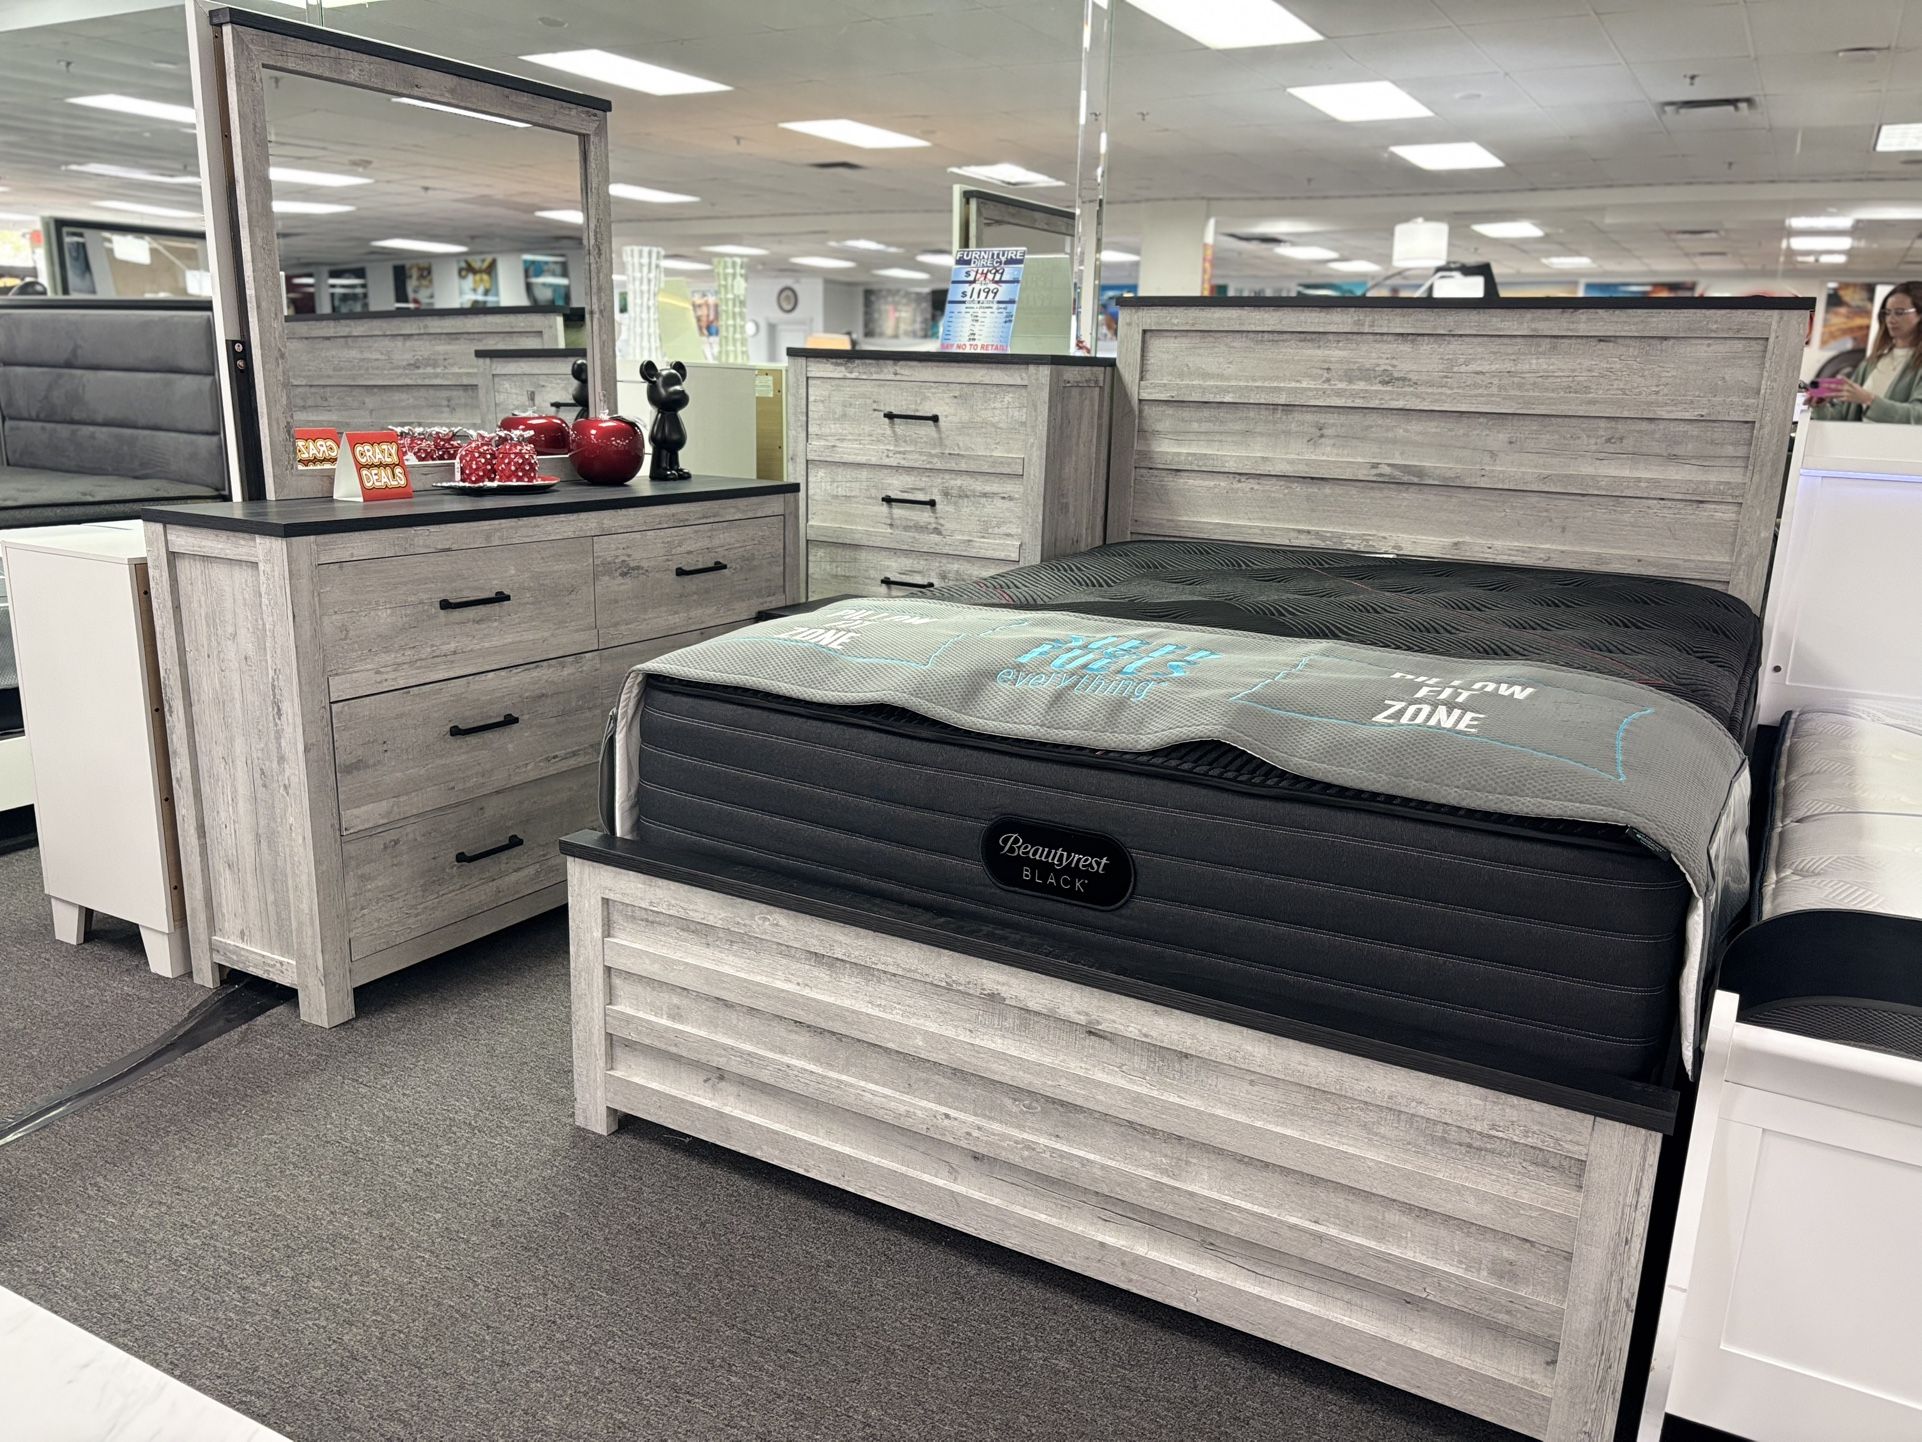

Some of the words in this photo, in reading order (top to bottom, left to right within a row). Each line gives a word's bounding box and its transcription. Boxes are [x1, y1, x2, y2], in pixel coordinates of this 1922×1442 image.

[956, 250, 1025, 260] FURNITURE
[971, 259, 1006, 267] DIRECT
[961, 287, 1000, 300] $1199
[355, 443, 399, 464] CRAZY
[361, 466, 407, 488] DEALS
[775, 627, 861, 650] ZONE
[996, 667, 1155, 703] everything
[1413, 686, 1482, 703] FIT
[1371, 700, 1487, 733] ZONE
[999, 833, 1110, 873] Beautyrest
[1023, 867, 1085, 892] BLACK
